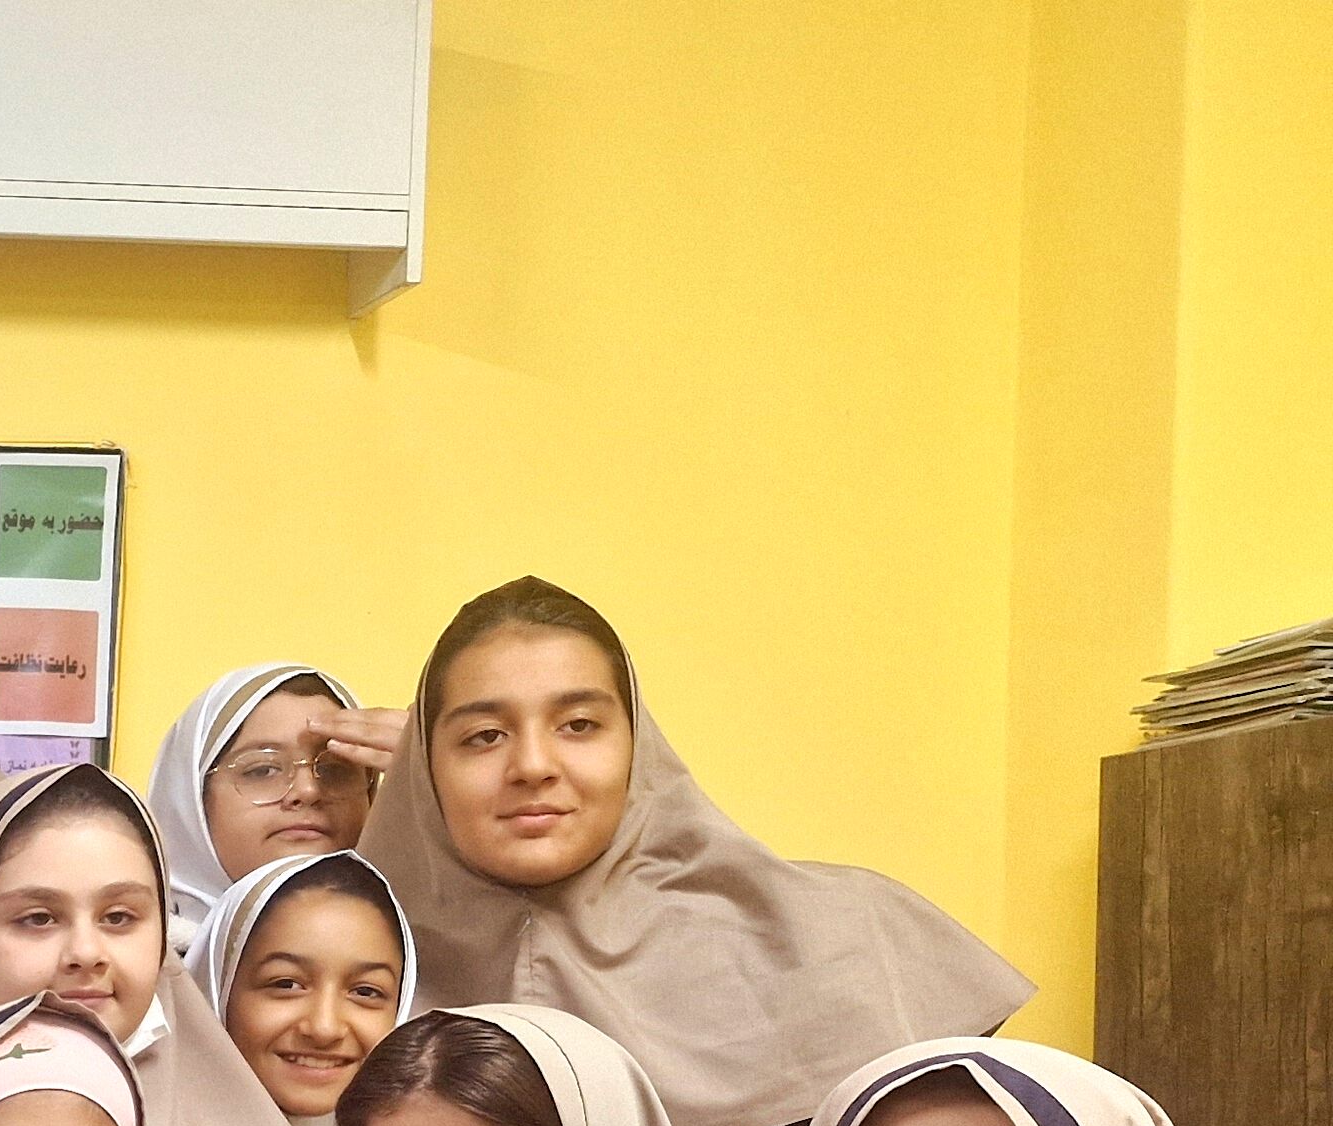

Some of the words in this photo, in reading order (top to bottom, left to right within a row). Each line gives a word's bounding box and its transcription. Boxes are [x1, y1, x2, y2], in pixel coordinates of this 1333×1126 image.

[1, 508, 36, 533] موقع
[41, 515, 55, 534] به
[56, 513, 104, 535] حضور
[43, 654, 87, 680] رعایت
